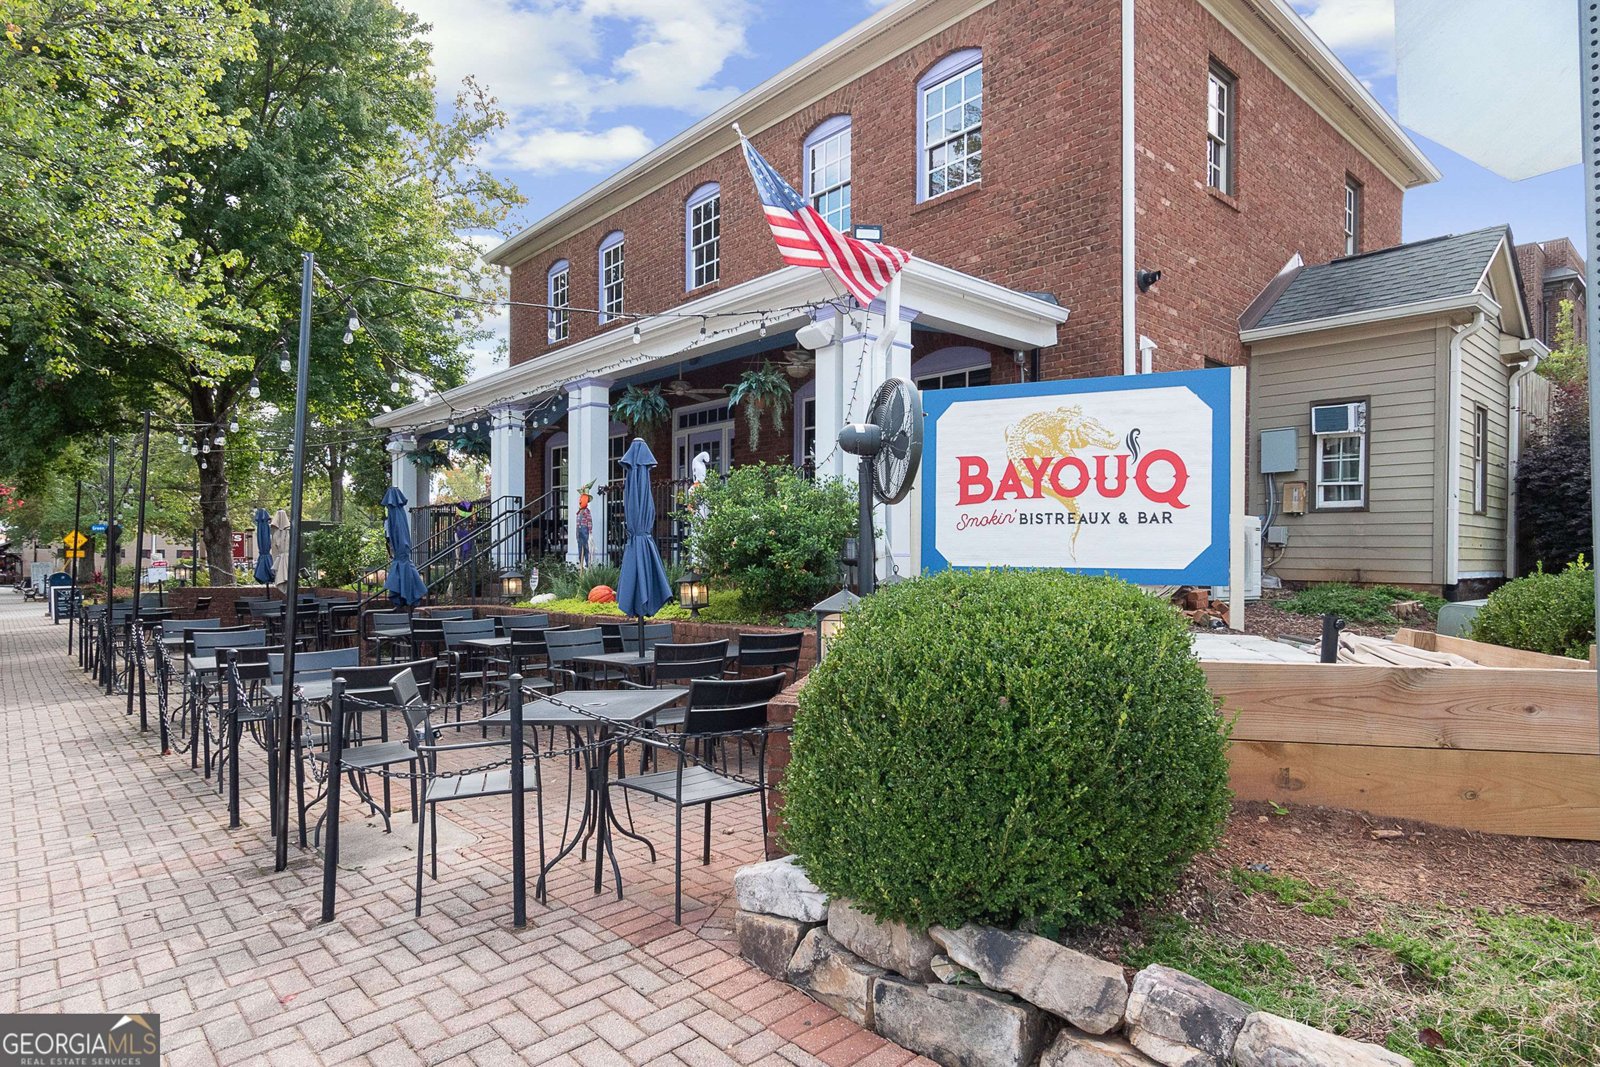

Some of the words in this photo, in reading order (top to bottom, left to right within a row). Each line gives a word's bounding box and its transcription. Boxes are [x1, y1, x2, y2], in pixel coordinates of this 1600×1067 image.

[956, 508, 1017, 531] Smokin'
[1019, 511, 1111, 525] BISTREAUX
[1118, 512, 1129, 524] &
[1138, 511, 1173, 524] BAR
